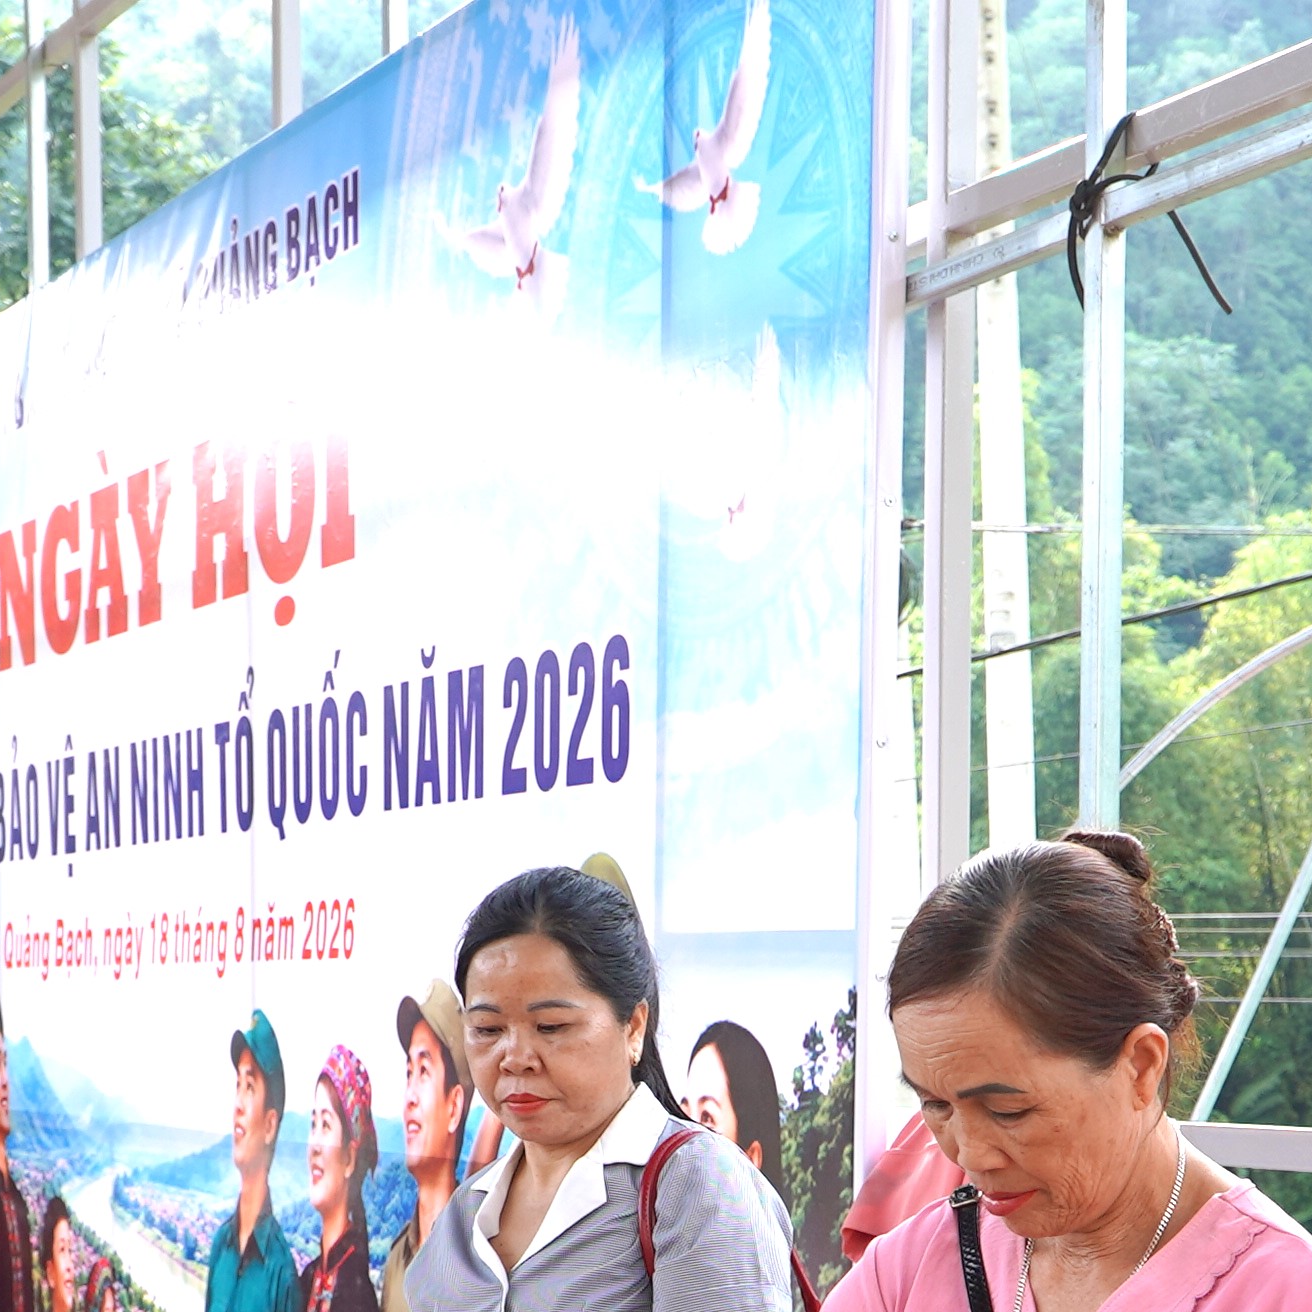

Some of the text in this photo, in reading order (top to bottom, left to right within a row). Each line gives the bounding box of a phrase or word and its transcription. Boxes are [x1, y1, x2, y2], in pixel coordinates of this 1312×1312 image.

[286, 169, 359, 287] BẠCH
[47, 734, 76, 877] VỆ
[87, 746, 121, 851] AN
[130, 727, 204, 845] NINH
[214, 666, 254, 833] TỔ
[267, 649, 367, 841] QUỐC
[383, 645, 484, 812] NĂM
[501, 634, 630, 796] 2026
[4, 898, 355, 981] Quảng Bạch, ngày 18 tháng 8 năm 2026
